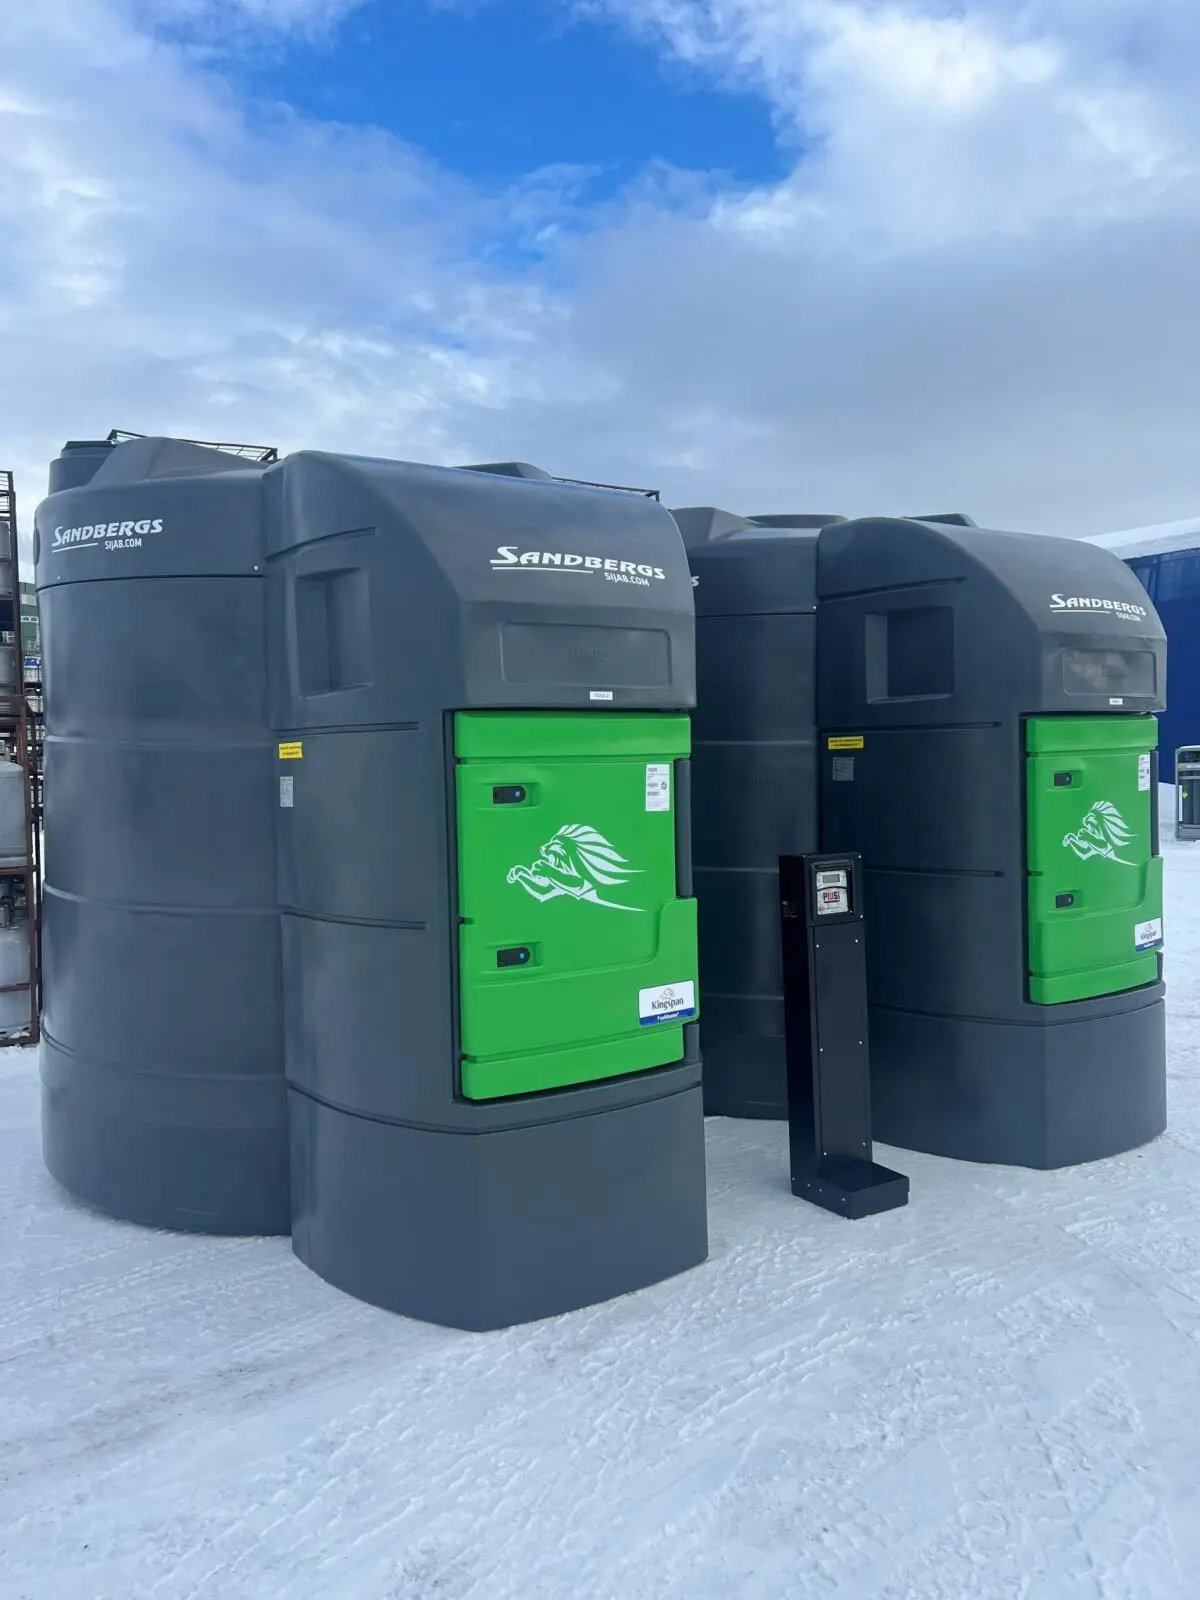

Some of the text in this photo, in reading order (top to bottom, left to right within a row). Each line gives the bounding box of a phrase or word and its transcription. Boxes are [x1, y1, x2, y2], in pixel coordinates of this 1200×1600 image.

[51, 519, 163, 547] SANDBERGS
[104, 538, 142, 551] SIJAB.COM
[490, 546, 666, 580] SANDBERGS
[604, 572, 650, 587] SIJAB.COM
[1049, 593, 1147, 616] SANDBERGS
[651, 997, 684, 1010] Kingspan
